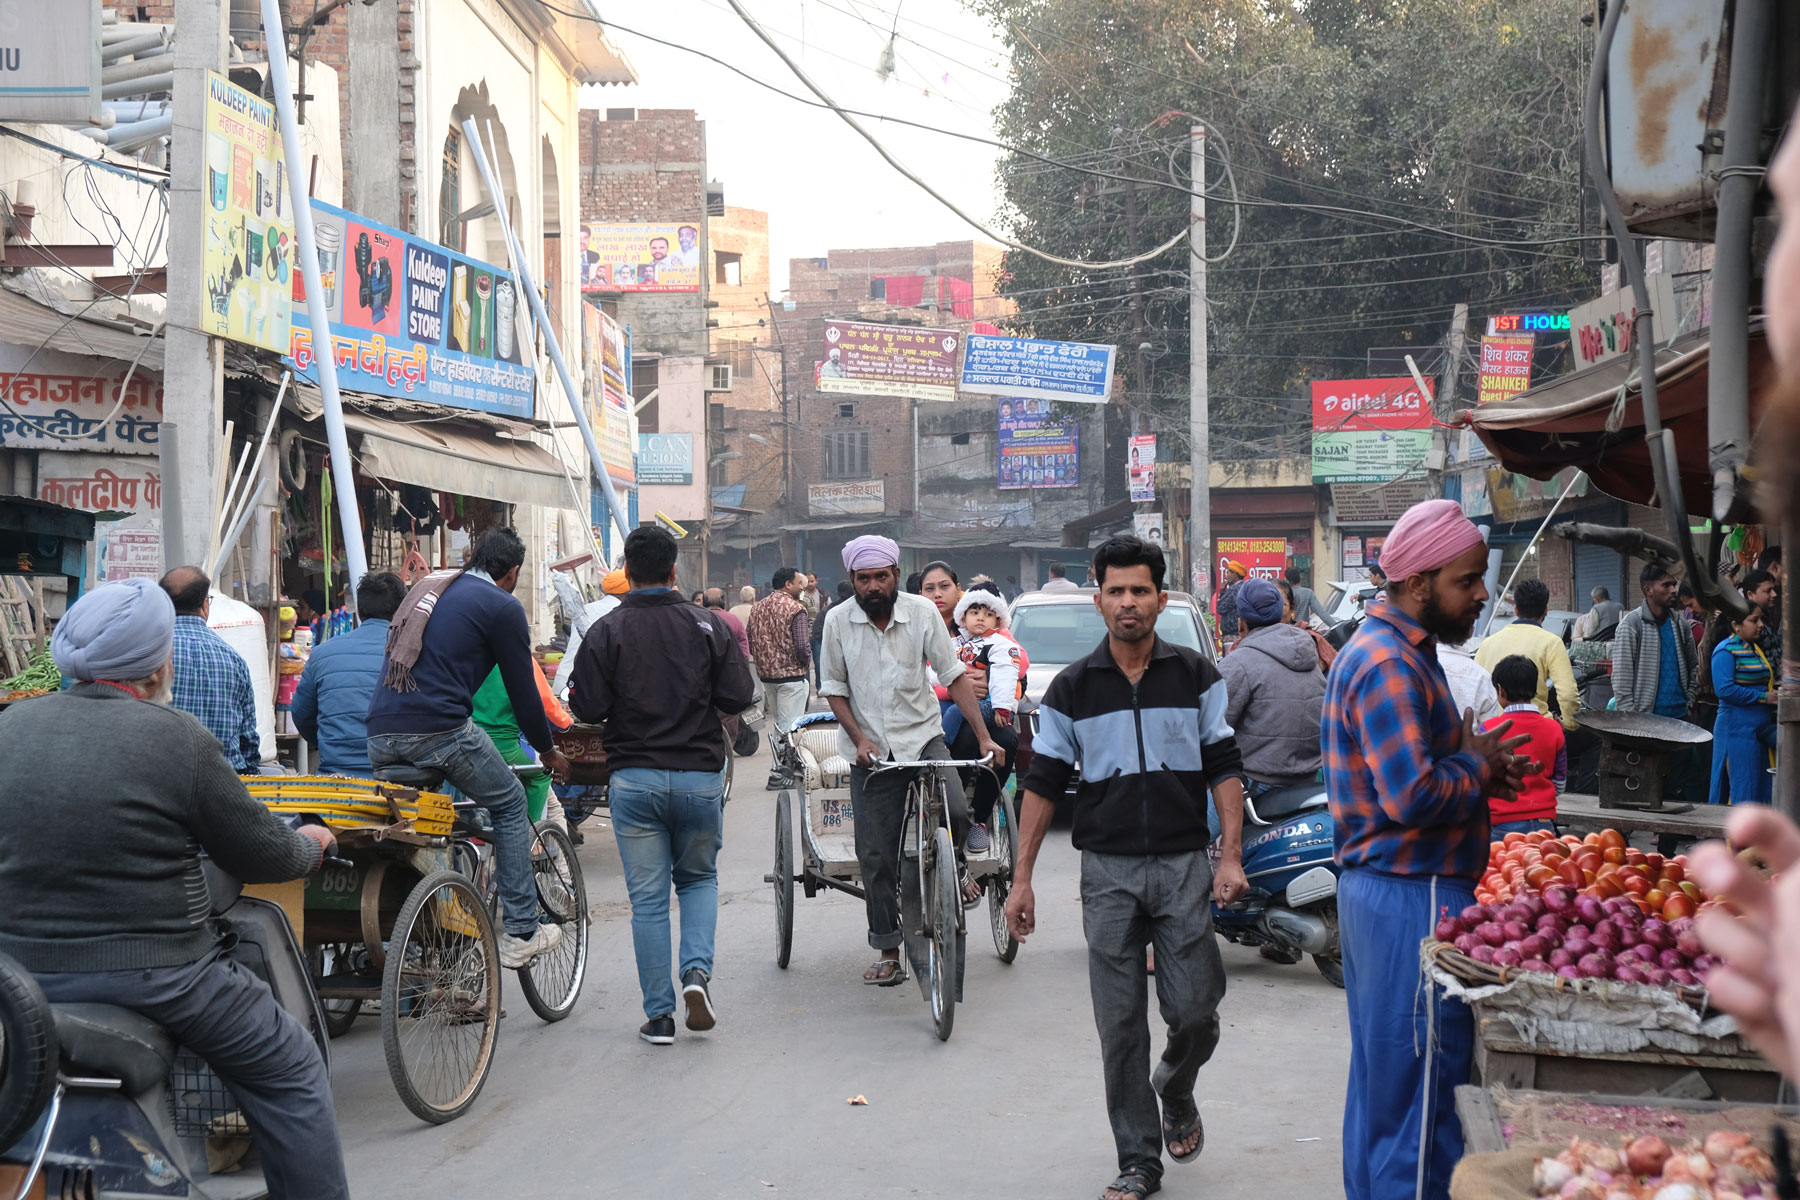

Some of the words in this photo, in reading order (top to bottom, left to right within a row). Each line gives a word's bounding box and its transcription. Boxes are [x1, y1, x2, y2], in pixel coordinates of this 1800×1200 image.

[211, 77, 247, 114] KULDEEP
[249, 98, 272, 128] PAINT
[407, 248, 447, 291] Kuldeep
[412, 284, 440, 313] PAINT
[410, 311, 440, 340] STORE
[361, 333, 386, 376] दी
[1484, 344, 1503, 362] शिव
[1505, 346, 1529, 363] शंकर
[112, 369, 152, 410] दी
[1481, 375, 1528, 391] SHANKER
[1341, 393, 1388, 411] airtel
[1392, 393, 1419, 410] 4G
[1480, 391, 1502, 402] Guest
[1314, 445, 1349, 456] SAJAN
[144, 472, 160, 510] पें
[1218, 541, 1249, 555] 9814134157,
[1250, 541, 1285, 553] 0183-2543000
[823, 814, 841, 826] 086
[1247, 822, 1312, 850] HONDA
[322, 869, 359, 893] 869
